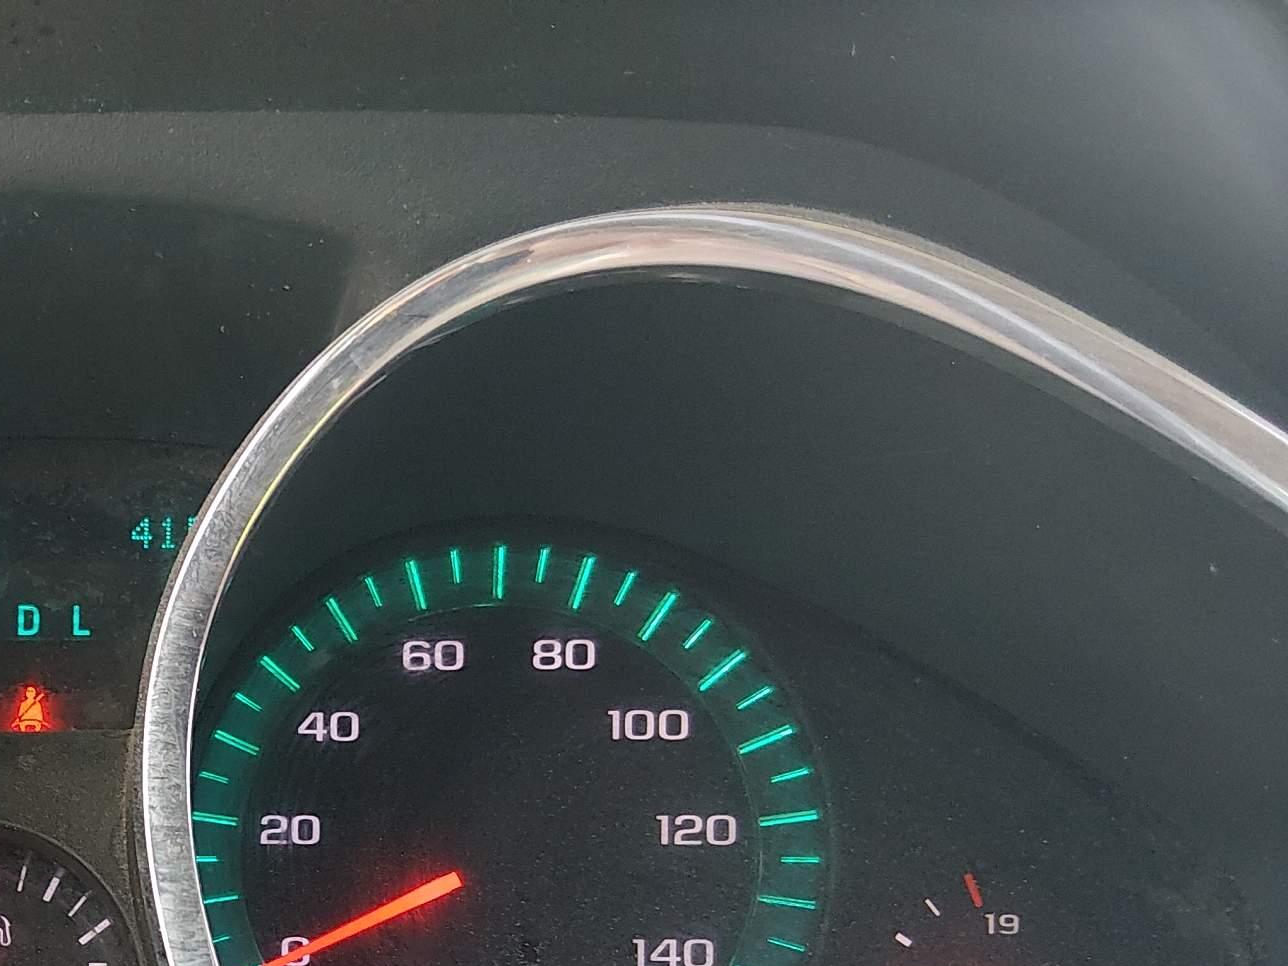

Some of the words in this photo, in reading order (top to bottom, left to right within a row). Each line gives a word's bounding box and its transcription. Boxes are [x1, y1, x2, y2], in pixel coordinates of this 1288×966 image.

[17, 604, 41, 636] D
[72, 604, 91, 636] L
[402, 640, 465, 671] 60
[532, 639, 596, 670] 80
[297, 711, 360, 742] 40
[607, 709, 689, 741] 100
[260, 814, 321, 845] 20
[656, 814, 737, 846] 120
[985, 913, 1020, 935] 19
